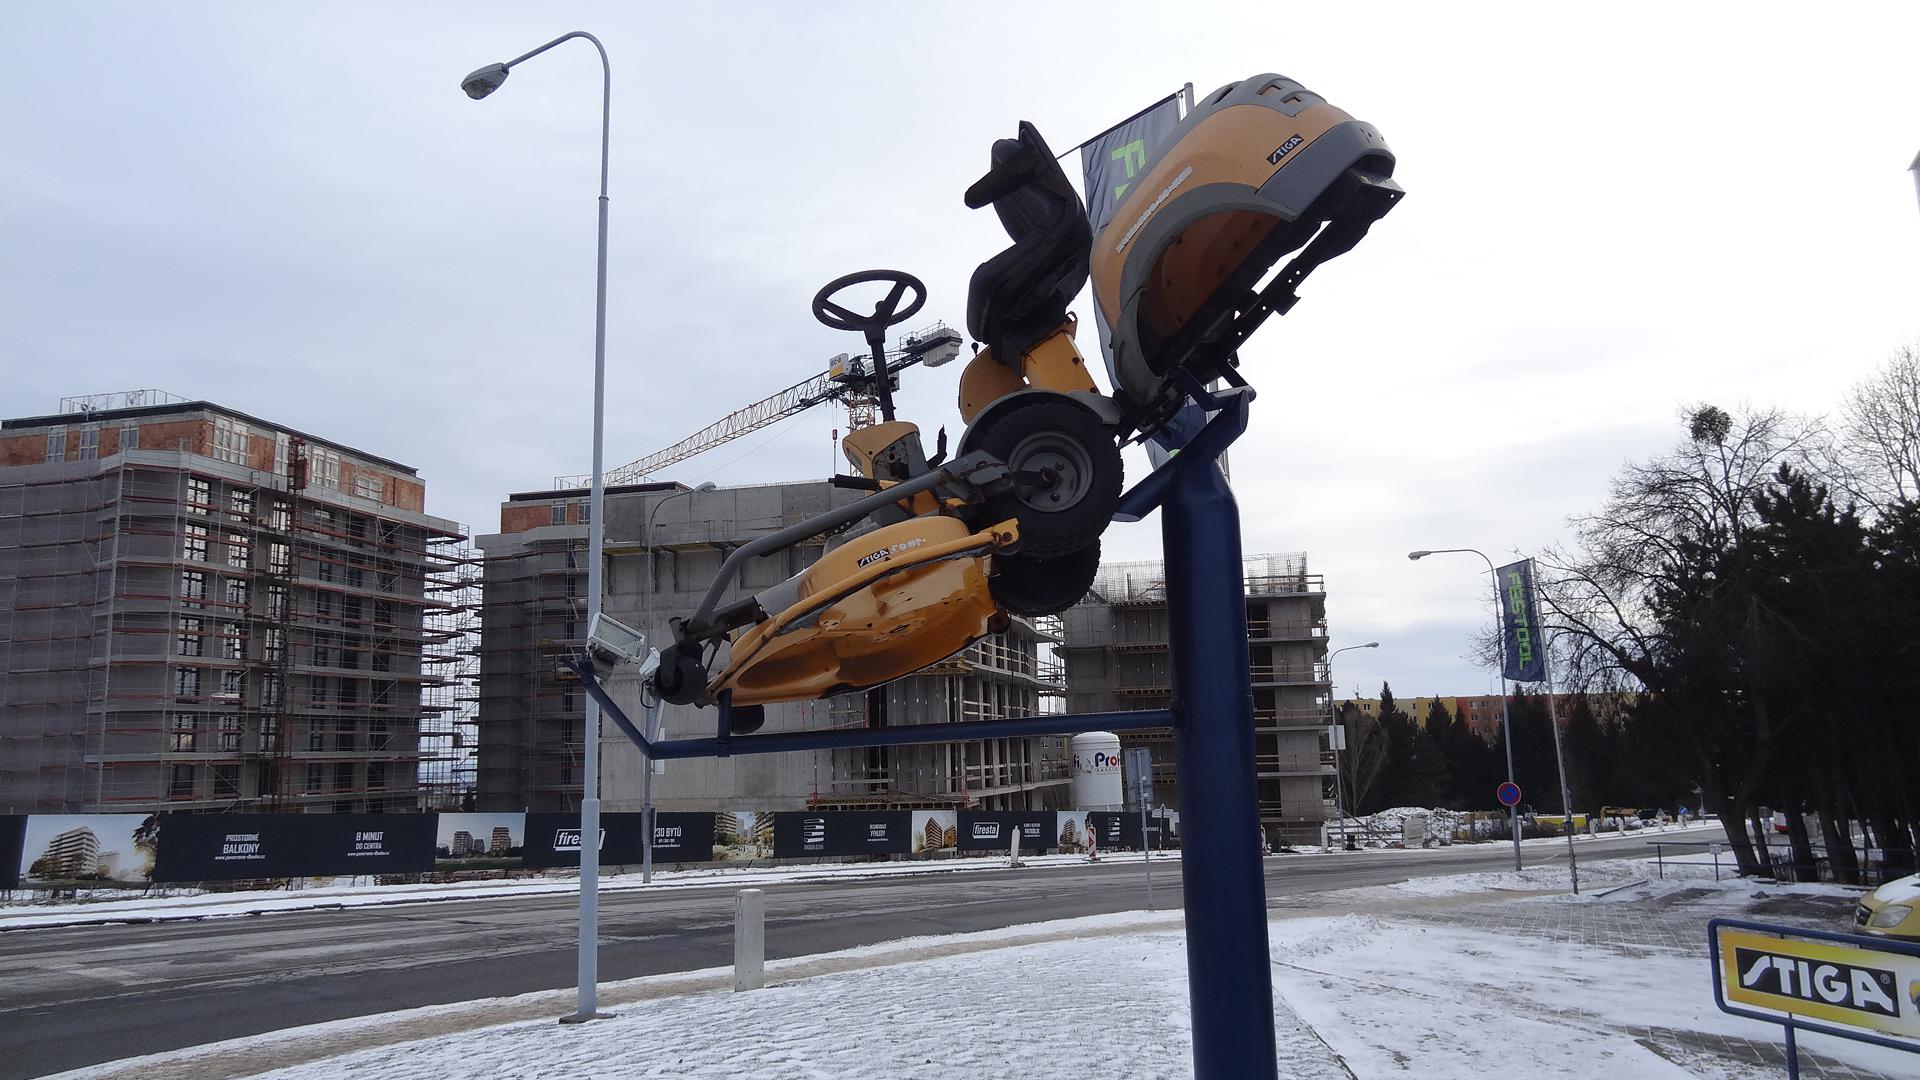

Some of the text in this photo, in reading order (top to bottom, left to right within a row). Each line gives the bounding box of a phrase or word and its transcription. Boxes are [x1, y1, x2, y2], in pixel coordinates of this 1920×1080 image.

[1272, 137, 1302, 163] STIGA
[860, 549, 889, 567] STIGA
[1507, 570, 1532, 671] FESTOOL
[355, 831, 384, 841] 8 MINUT
[974, 824, 997, 835] firesta
[558, 832, 582, 845] fire
[223, 843, 260, 854] BALKONY
[1743, 955, 1894, 1013] STIGA
